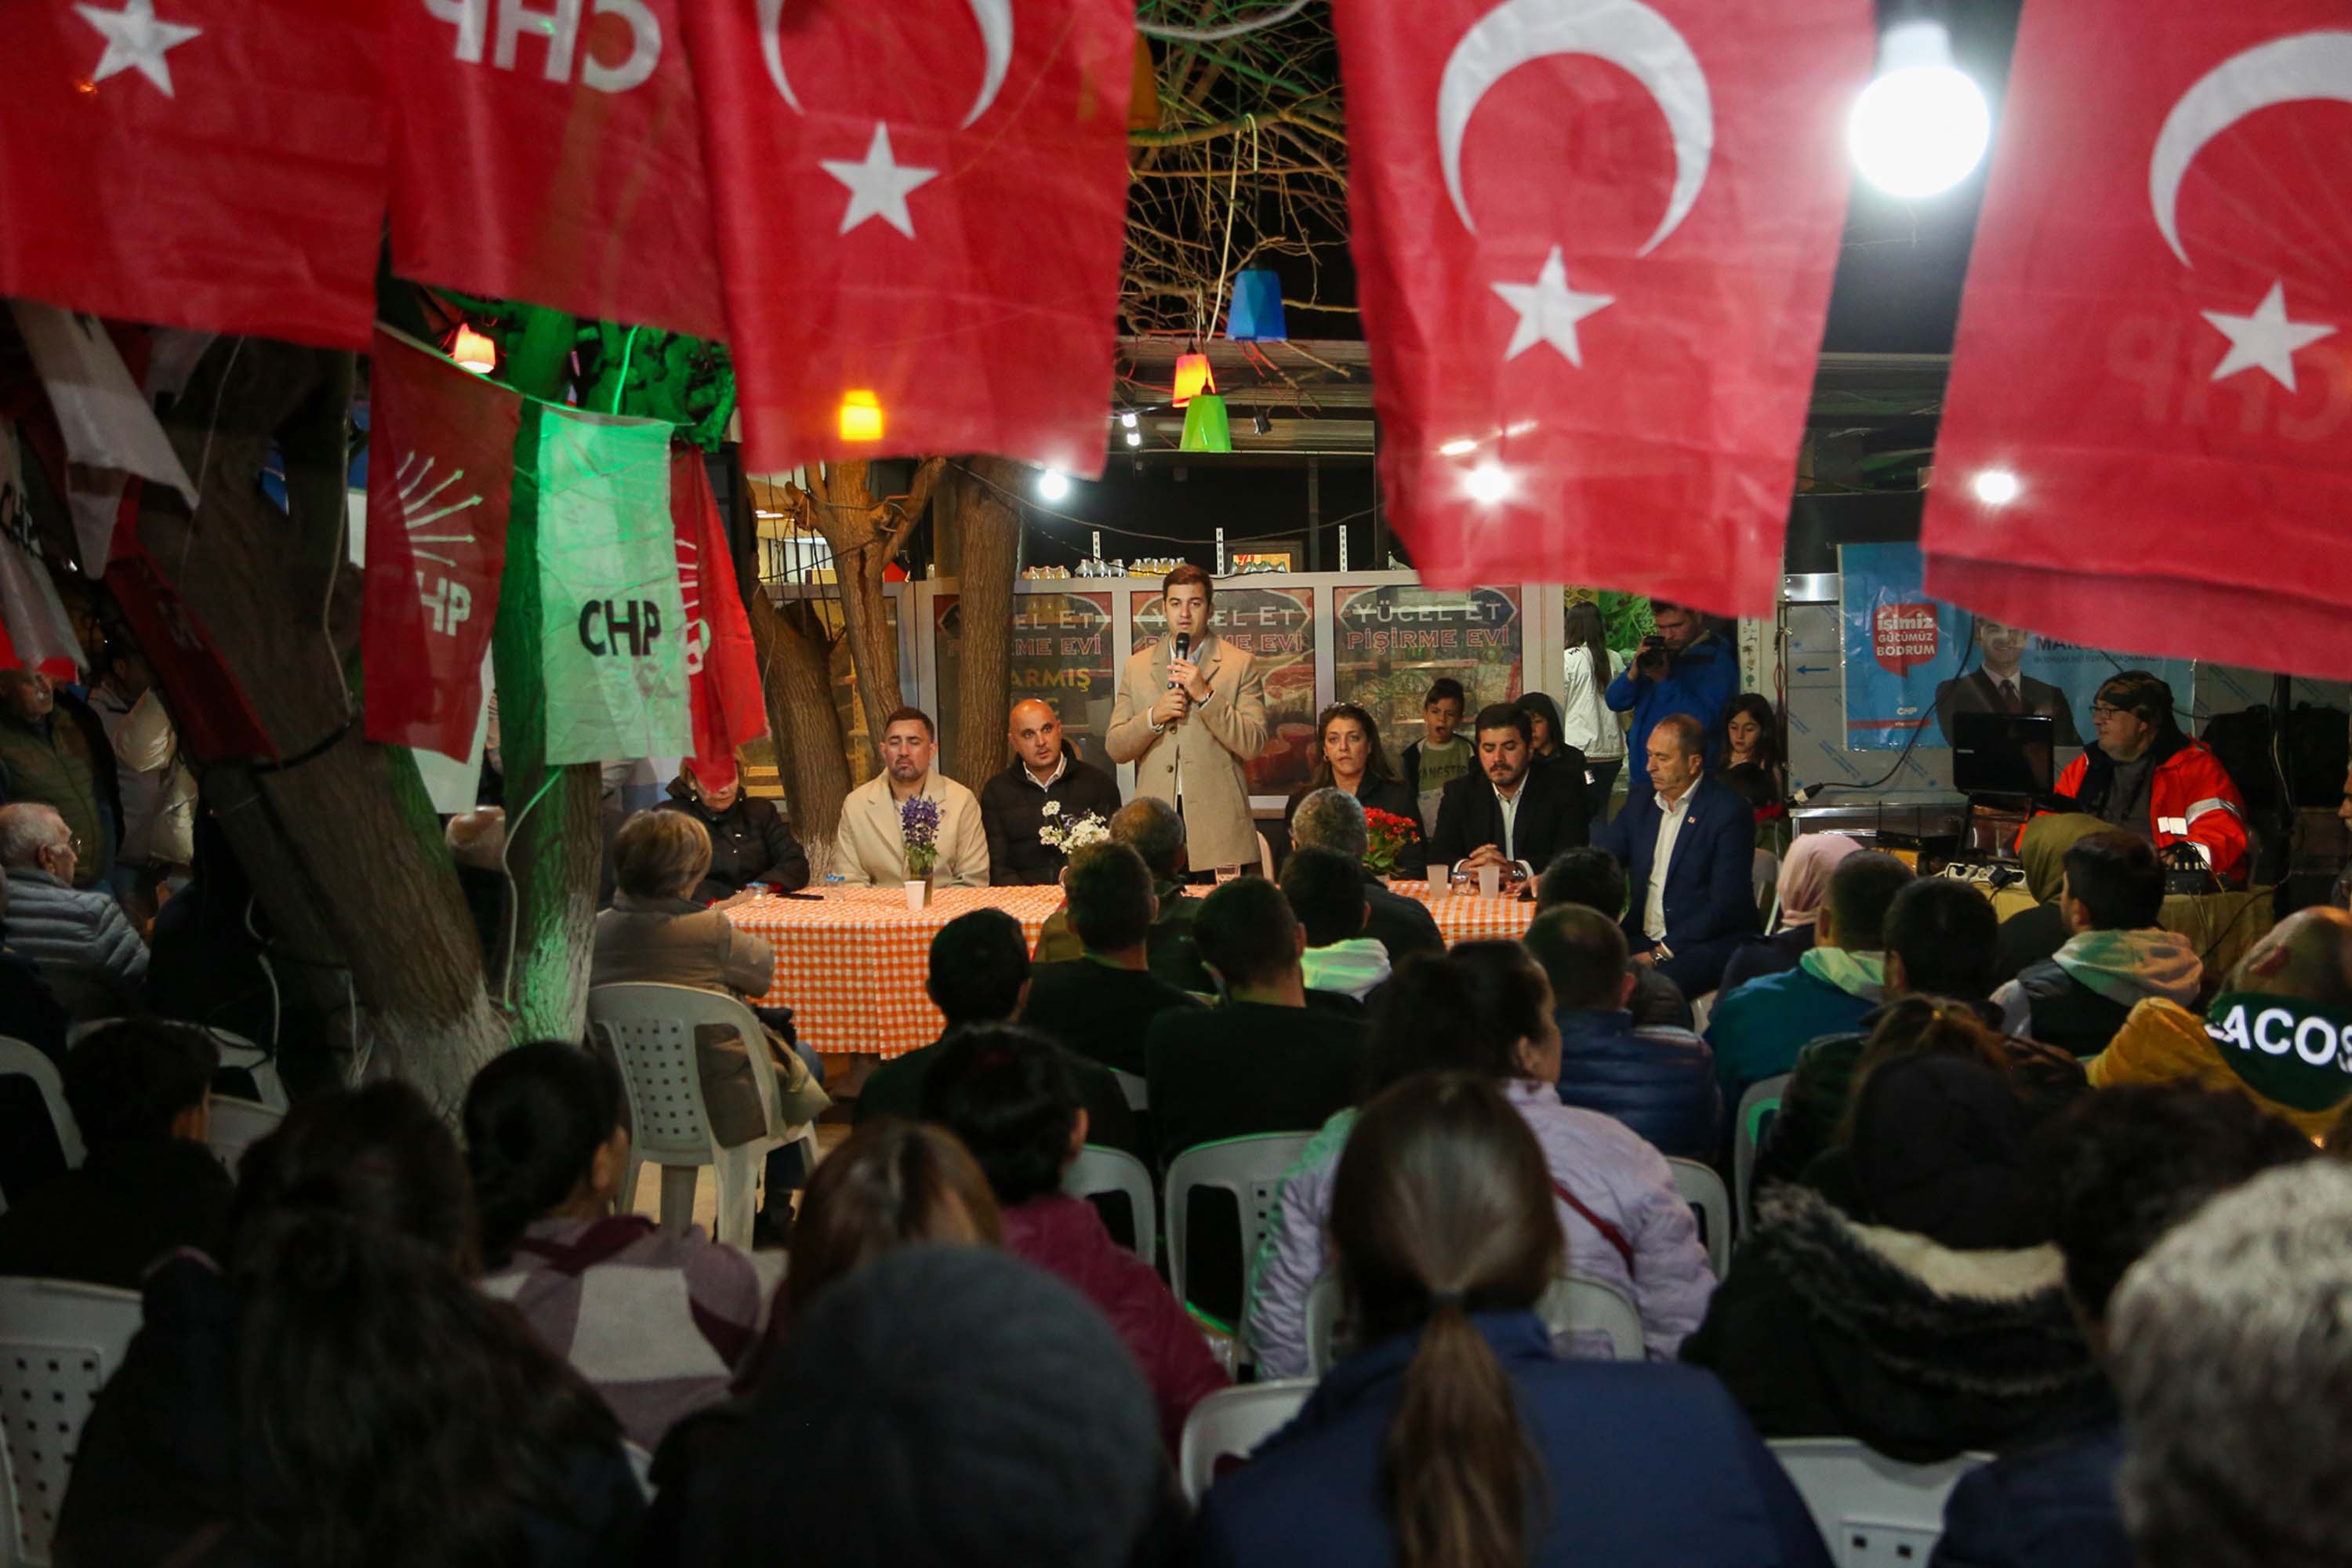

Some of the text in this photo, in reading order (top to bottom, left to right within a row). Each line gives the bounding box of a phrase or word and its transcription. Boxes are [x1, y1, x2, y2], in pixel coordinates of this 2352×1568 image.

[414, 568, 473, 637] HP
[1353, 600, 1501, 622] YÜCEL ET
[1059, 610, 1094, 630] ET
[1259, 605, 1295, 626] ET
[579, 600, 662, 657] CHP
[1061, 633, 1102, 656] EVİ
[1260, 630, 1304, 652] EVİ
[1347, 625, 1510, 655] PİŞİRME EVİ
[1876, 644, 1936, 656] BODRUM
[1011, 667, 1091, 692] ARMIŞ
